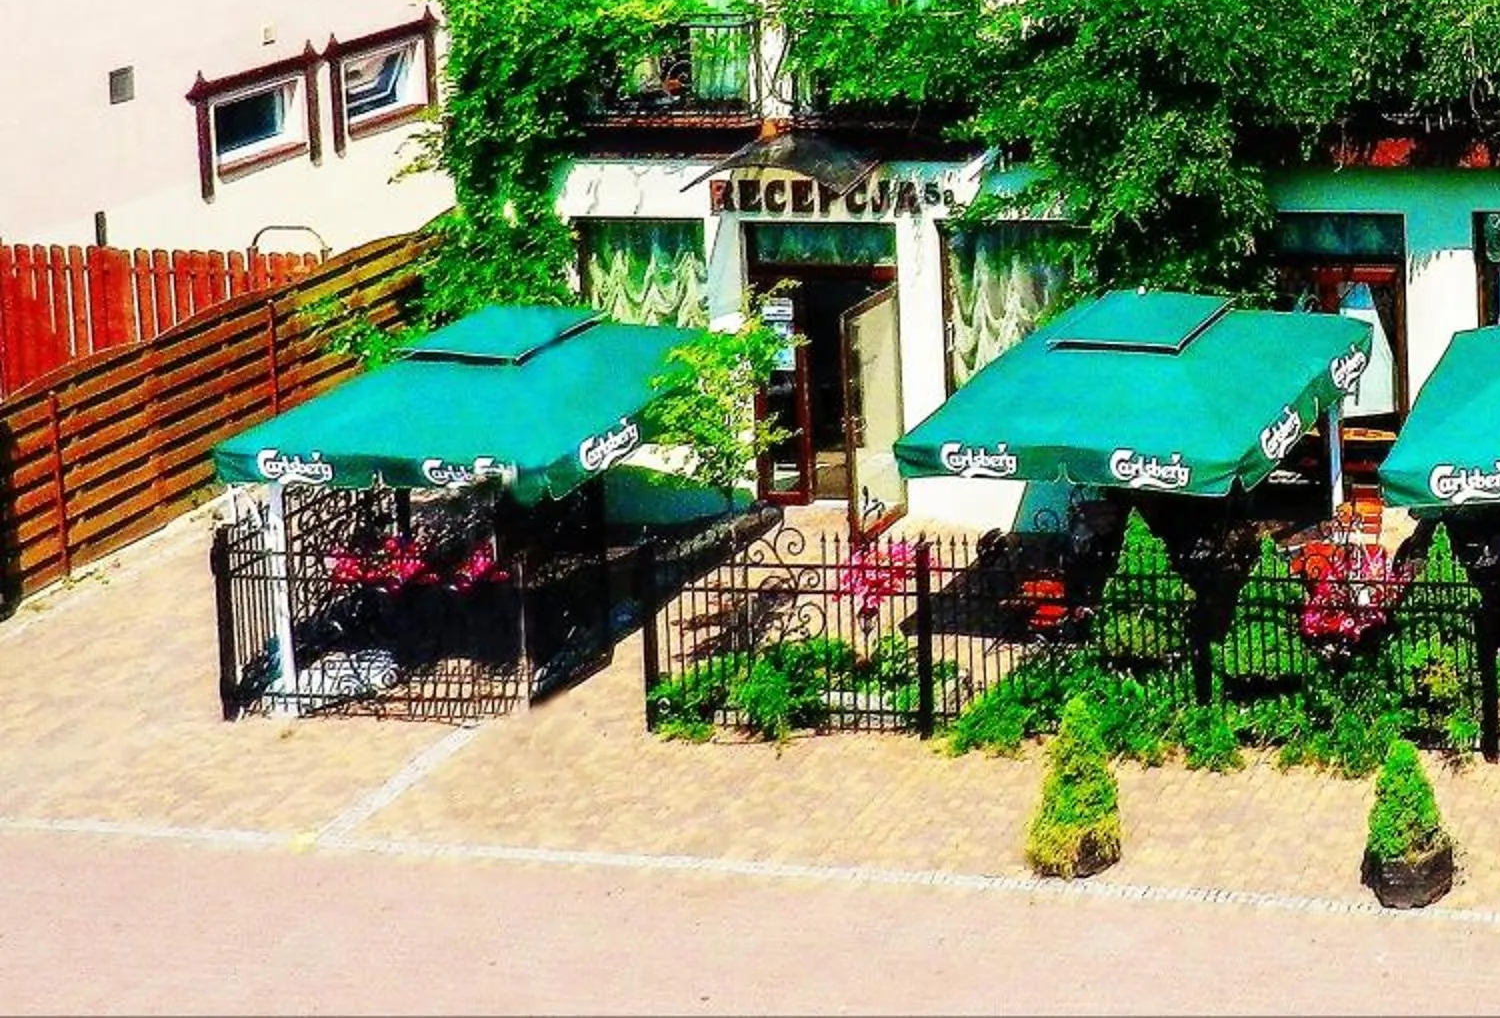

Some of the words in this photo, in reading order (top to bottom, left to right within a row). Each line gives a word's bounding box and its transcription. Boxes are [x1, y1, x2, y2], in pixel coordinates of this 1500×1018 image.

[578, 416, 640, 472] Carlsberg
[940, 442, 1017, 479] Carlsberg
[256, 449, 334, 483] Carlsberg
[1109, 447, 1191, 489] Carlsberg
